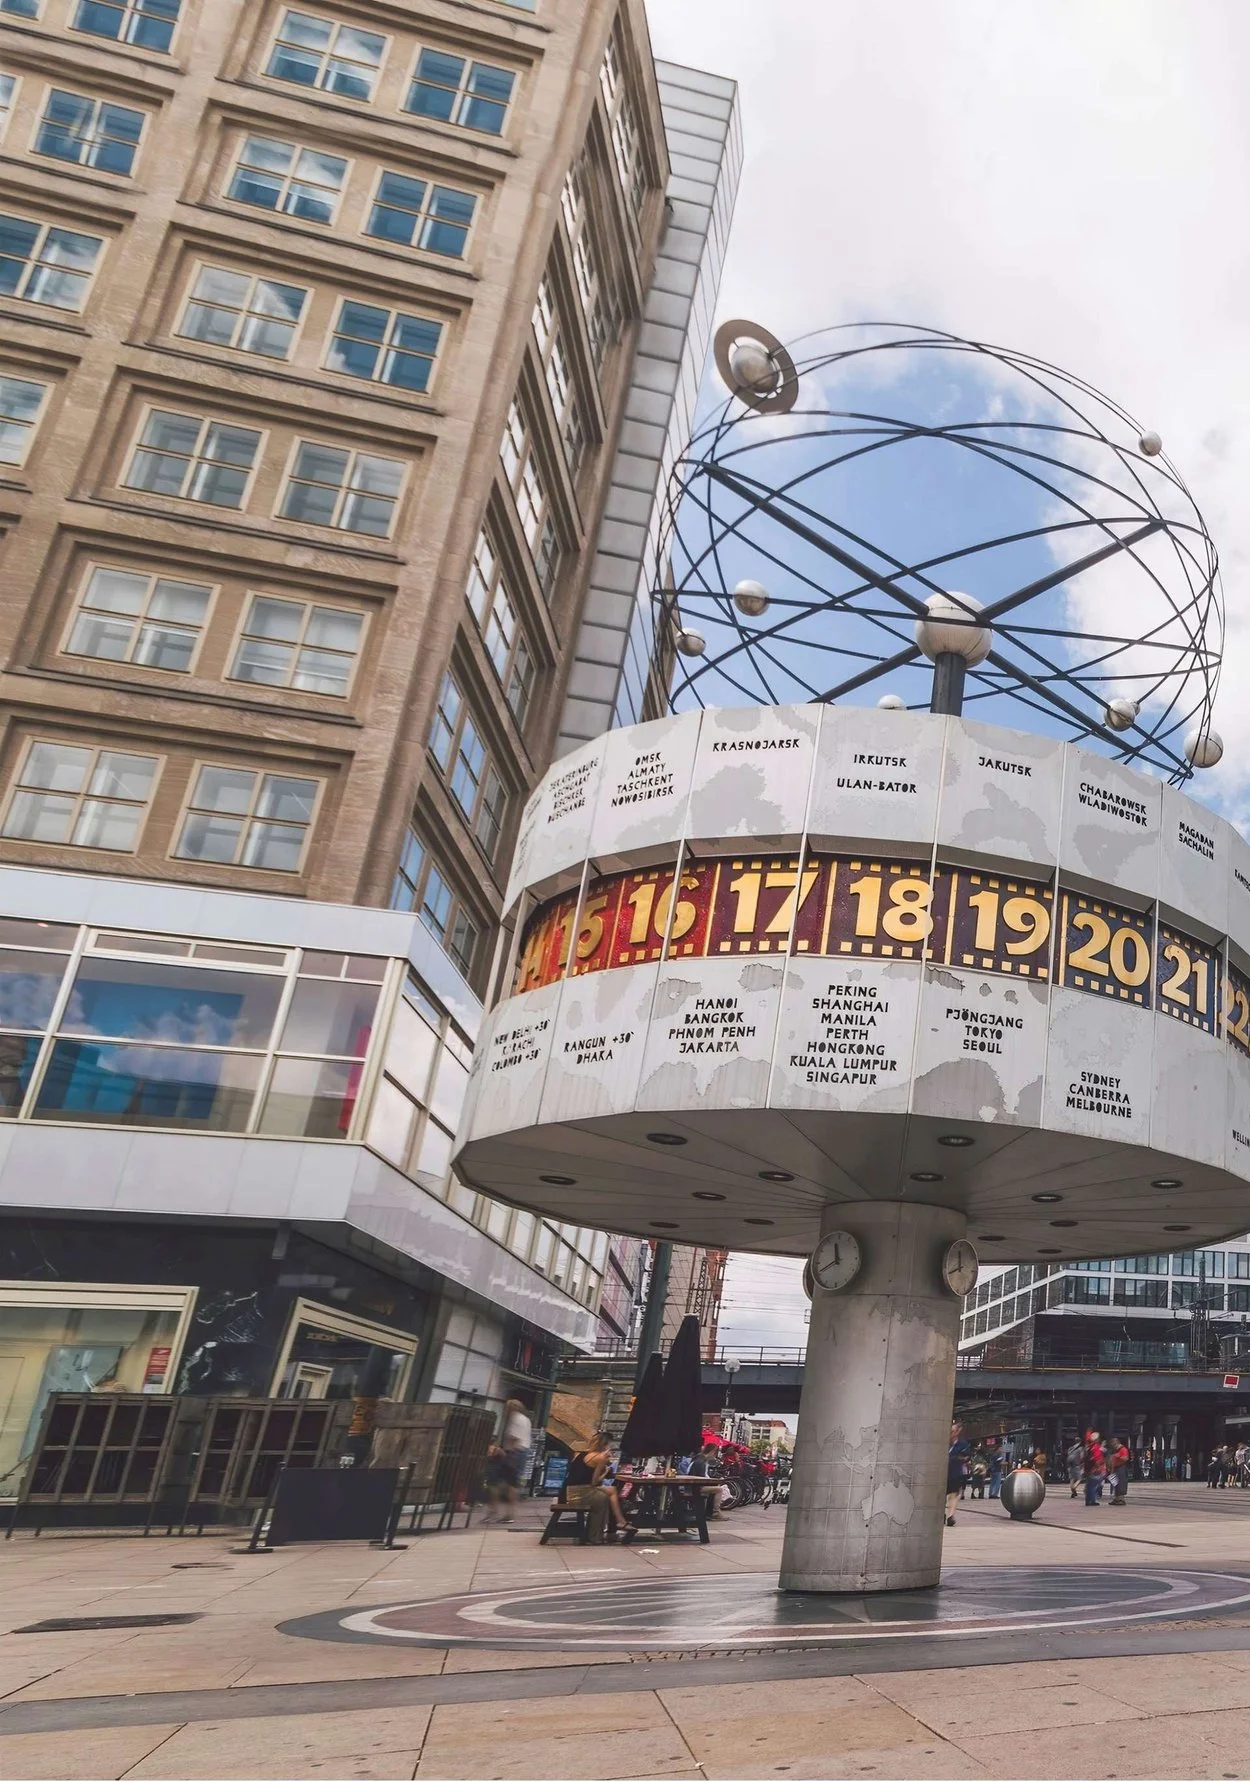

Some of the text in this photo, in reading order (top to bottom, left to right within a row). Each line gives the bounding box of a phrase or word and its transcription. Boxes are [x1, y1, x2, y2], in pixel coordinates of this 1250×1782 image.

[712, 738, 800, 752] KRASNOJARSK
[635, 752, 661, 766] OMSK
[853, 754, 907, 767] IRKUTSK
[978, 756, 1032, 777] JAKUTSK
[627, 763, 666, 780] ALMATY
[617, 773, 673, 794] TASCHKENT
[836, 777, 917, 793] ULAN-BATOR
[611, 786, 674, 808] NOWOSIBIRSK
[1080, 782, 1147, 815] CHABAROWSK
[1078, 793, 1148, 827] WLADIWOSTOK
[1179, 821, 1214, 849] MAGADAN
[1178, 833, 1214, 860] SACHALIN
[558, 894, 609, 966] 15
[628, 876, 700, 944] 16
[729, 871, 820, 934] 17
[849, 876, 934, 942] 18
[969, 890, 1051, 956] 19
[1068, 912, 1151, 987] 20
[1161, 944, 1208, 1015] 21
[1218, 977, 1250, 1048] 22
[827, 985, 878, 998] PEKING
[695, 998, 738, 1010] HANOI
[812, 998, 889, 1013] SHANGHAI
[684, 1012, 744, 1024] BANGKOK
[820, 1013, 877, 1026] MANILA
[946, 1008, 1024, 1029] PJÖNGJANG
[668, 1026, 756, 1039] PHNOM PENH
[826, 1027, 869, 1040] PERTH
[965, 1025, 1003, 1040] TOKYO
[502, 1037, 535, 1056] KRACHI
[563, 1036, 606, 1053] RANGUN
[679, 1041, 739, 1053] JAKARTA
[807, 1041, 885, 1056] HONGKONG
[962, 1039, 1002, 1054] SEOUL
[576, 1049, 613, 1065] DHAKA
[789, 1055, 897, 1071] KUALA LUMPUR
[806, 1071, 877, 1085] SINGAPUR
[1080, 1071, 1121, 1088] SYDNEY
[1069, 1083, 1130, 1104] CANBERRA
[1066, 1096, 1132, 1118] MELBOURNE
